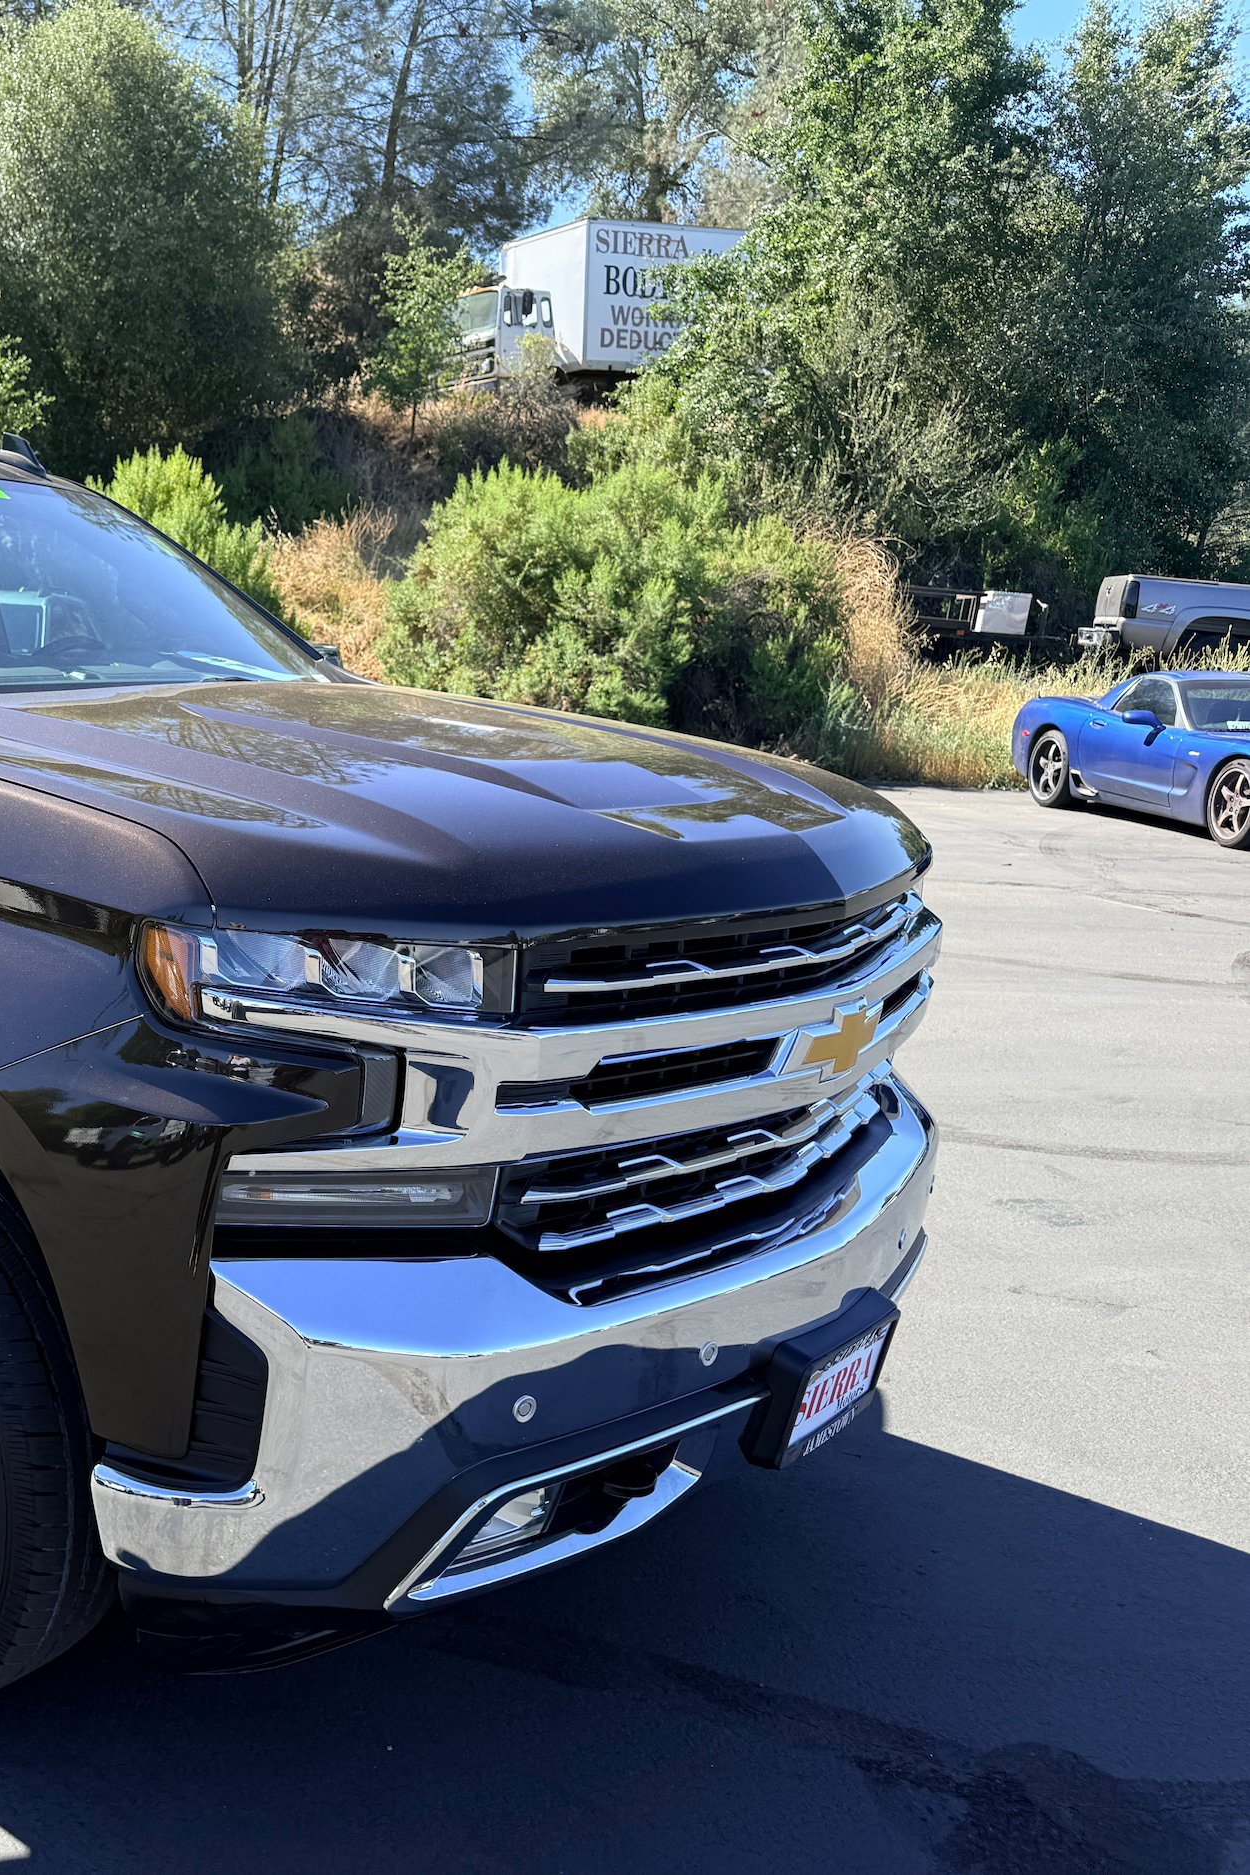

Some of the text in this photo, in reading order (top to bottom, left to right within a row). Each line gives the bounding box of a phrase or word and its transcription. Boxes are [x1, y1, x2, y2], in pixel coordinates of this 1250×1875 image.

[596, 228, 689, 258] SIERRA
[600, 327, 680, 351] DEDUC
[793, 1348, 874, 1427] SIERRA
[834, 1385, 865, 1414] Motors
[803, 1405, 859, 1456] JAMESTOWN
